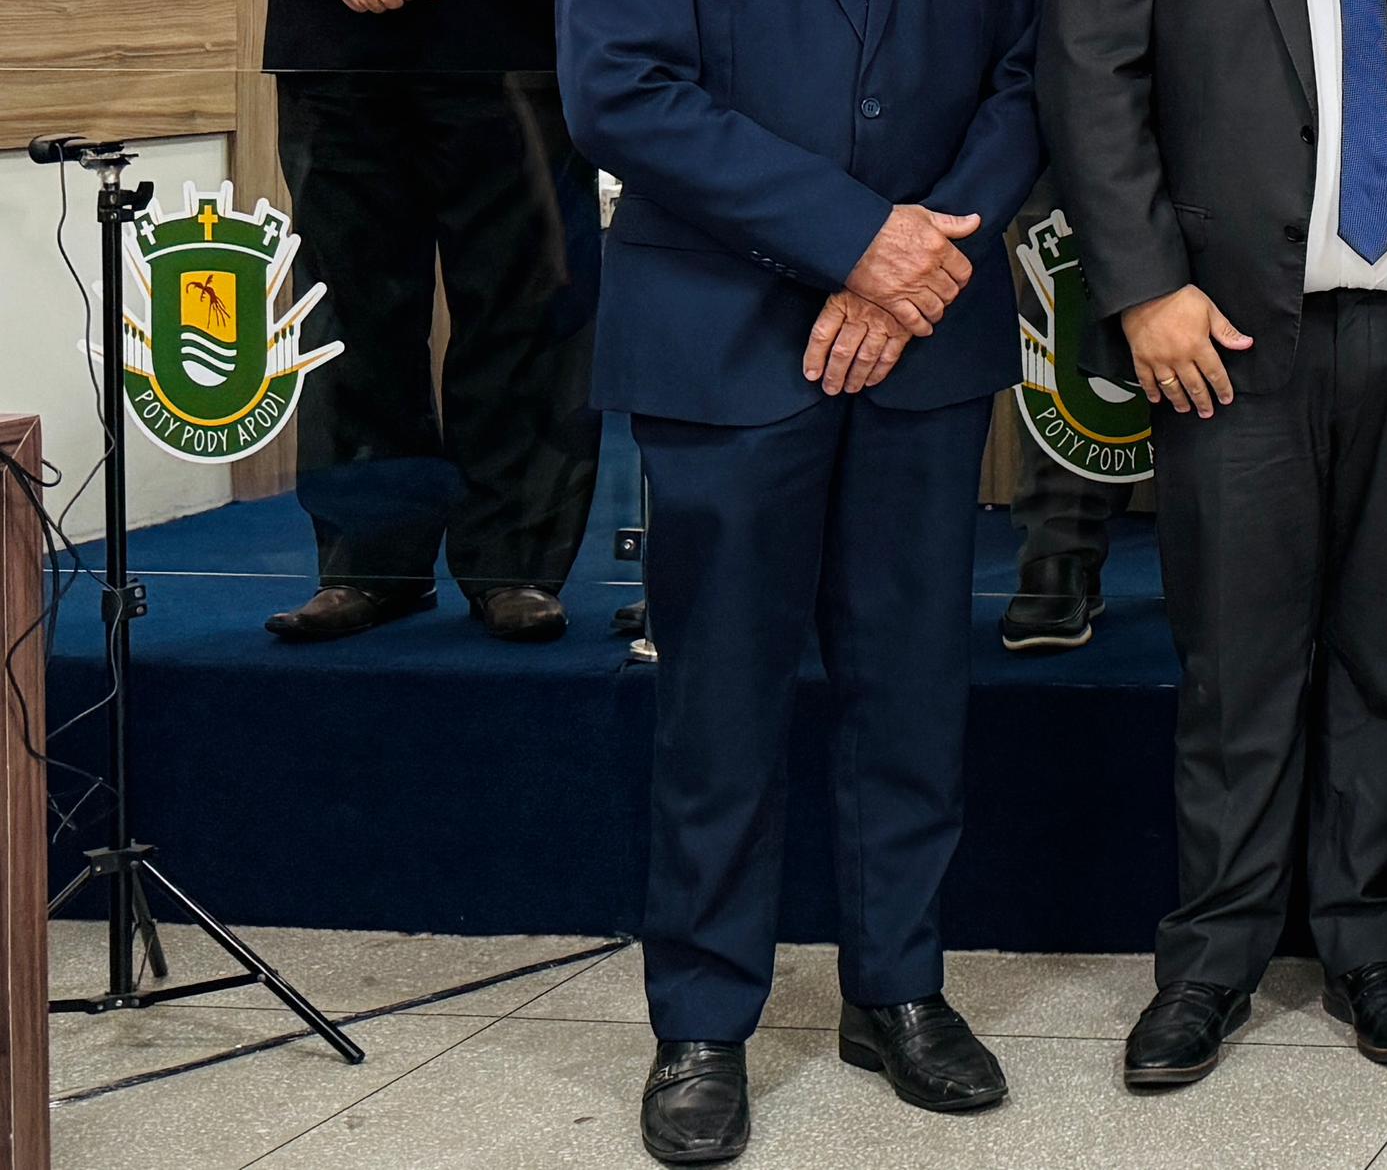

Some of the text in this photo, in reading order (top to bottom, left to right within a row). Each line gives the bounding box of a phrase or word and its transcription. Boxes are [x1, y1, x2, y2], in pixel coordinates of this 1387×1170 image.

[135, 389, 285, 453] POTY PODY APODI
[1035, 406, 1085, 457] POTY
[1085, 443, 1138, 471] PODY
